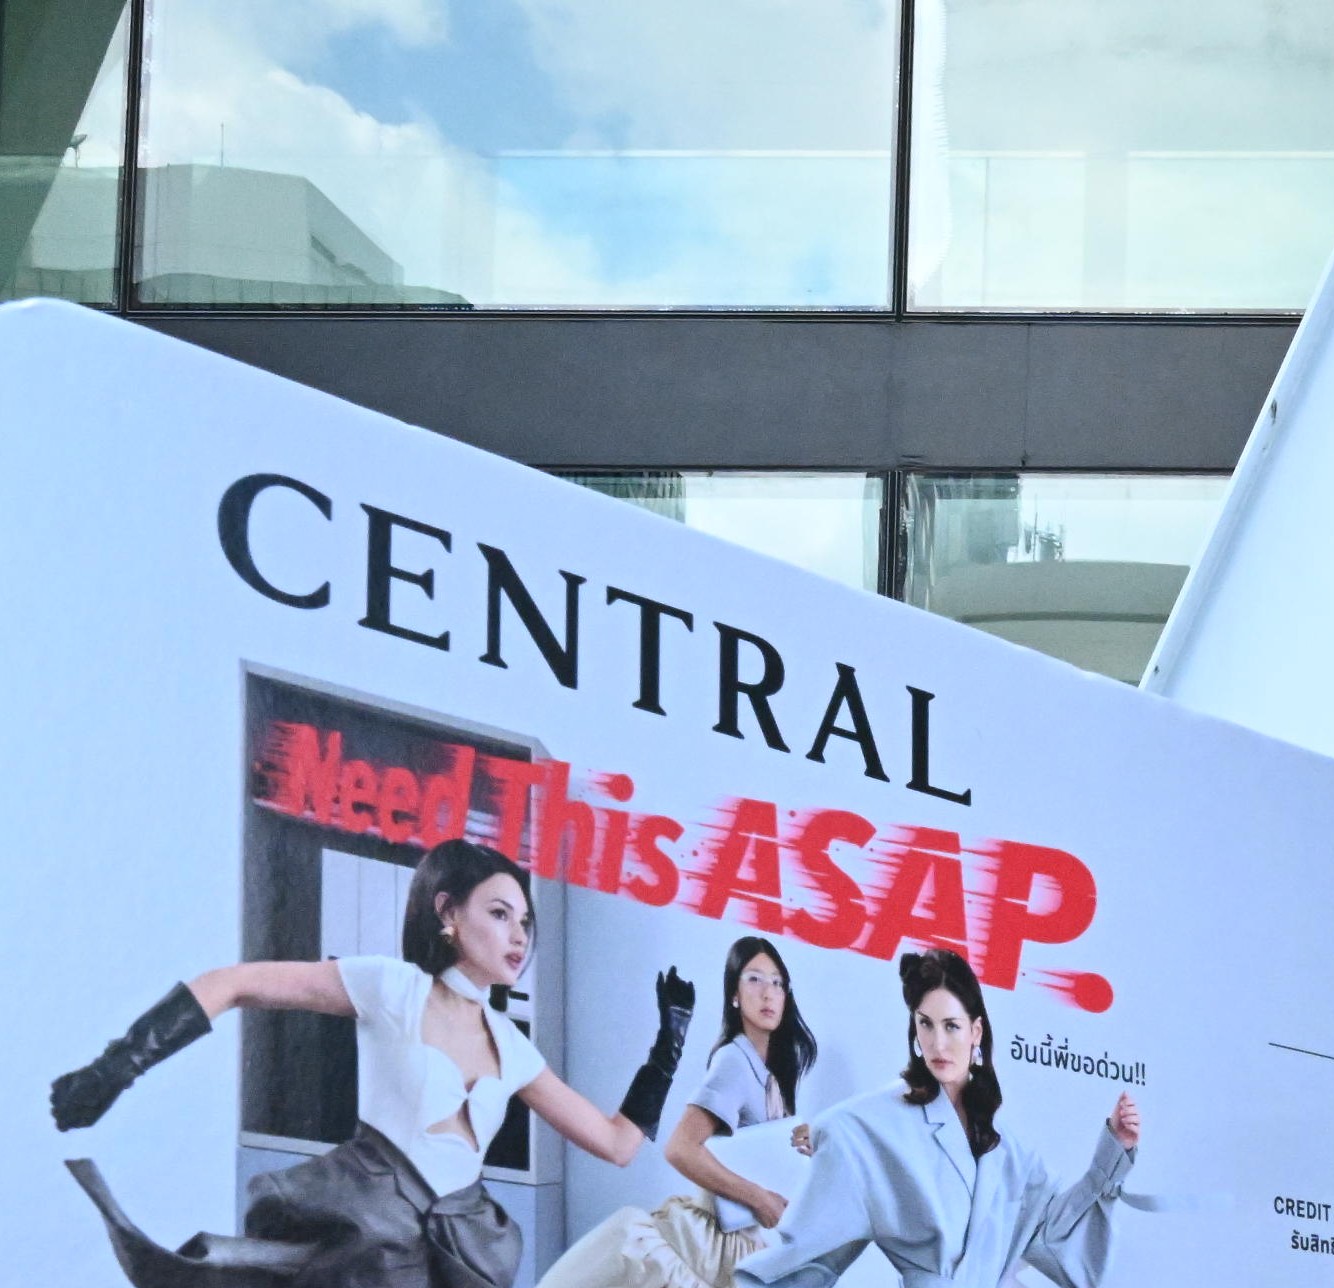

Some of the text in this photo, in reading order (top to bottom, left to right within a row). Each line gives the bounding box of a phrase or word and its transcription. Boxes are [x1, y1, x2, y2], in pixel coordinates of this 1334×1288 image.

[216, 472, 972, 807] CENTRAL
[256, 720, 1114, 1013] Need This ASAP.
[1009, 1033, 1147, 1088] อันนี้พี่ขอด่วน!!
[1273, 1195, 1332, 1224] CREDIT
